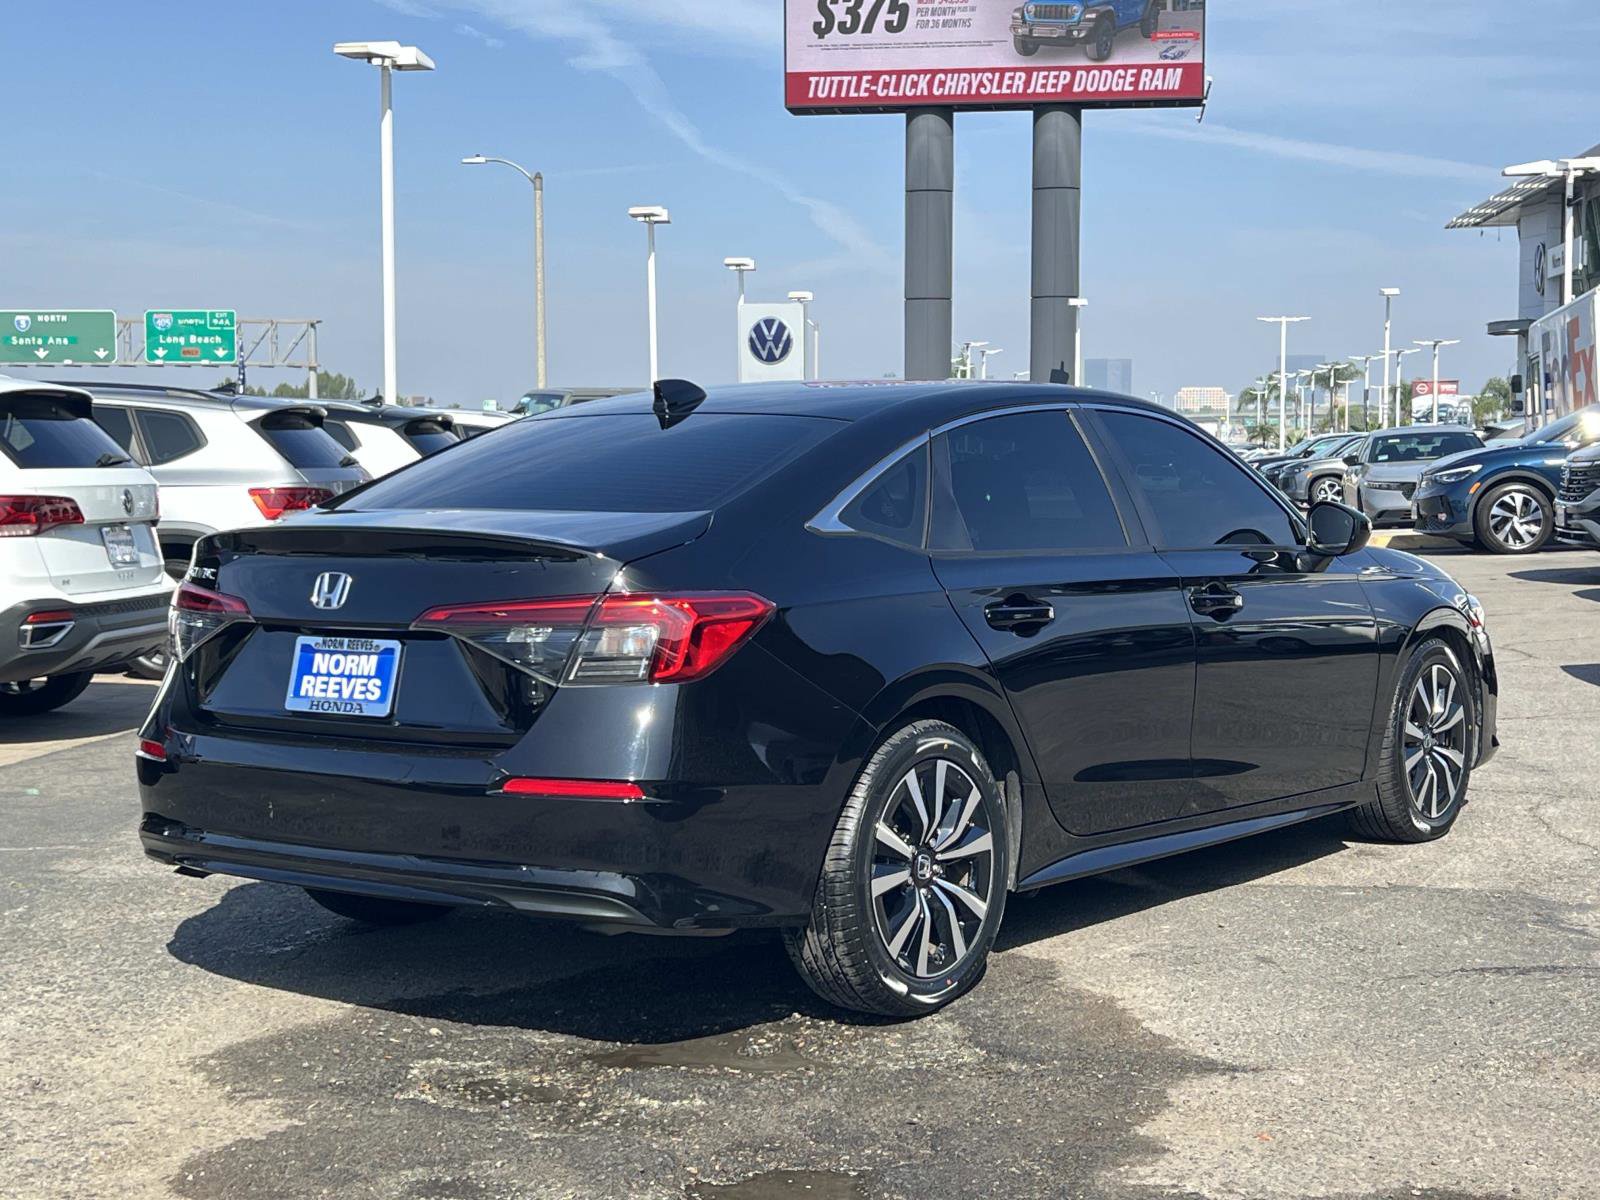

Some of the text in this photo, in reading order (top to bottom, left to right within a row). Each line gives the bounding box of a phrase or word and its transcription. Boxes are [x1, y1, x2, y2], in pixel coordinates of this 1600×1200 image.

[915, 7, 930, 17] PER
[930, 6, 957, 16] MONTH
[812, 0, 910, 39] $375
[915, 17, 972, 29] FOR 36 MONTHS
[808, 67, 1183, 98] TUTTLE-CLICK CHRYSLER JEEP DODGE RAM
[37, 314, 68, 322] NORTH
[11, 336, 69, 345] Santa Ana
[159, 334, 222, 346] Long Beach
[1541, 314, 1597, 420] FedEx
[322, 638, 374, 651] NORM REEVES
[312, 653, 379, 676] NORM
[300, 675, 382, 701] REEVES
[308, 700, 365, 713] HONDA
